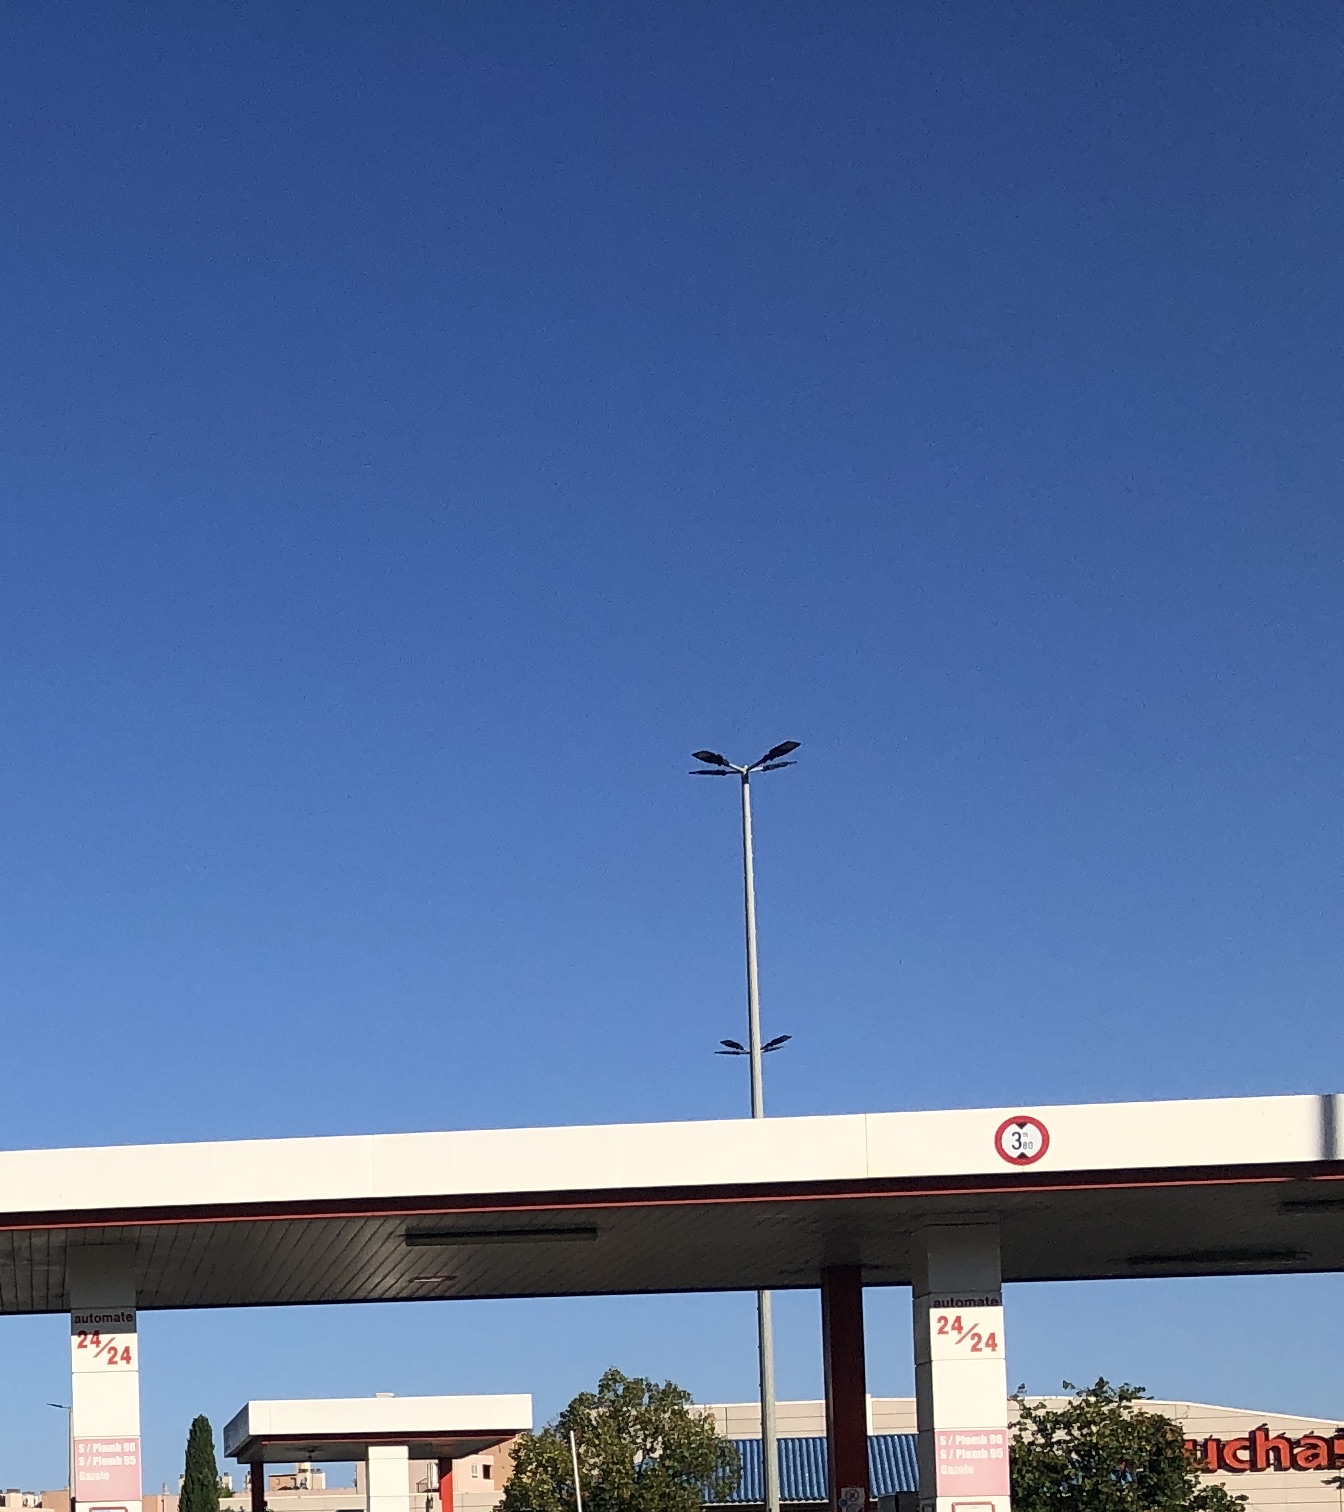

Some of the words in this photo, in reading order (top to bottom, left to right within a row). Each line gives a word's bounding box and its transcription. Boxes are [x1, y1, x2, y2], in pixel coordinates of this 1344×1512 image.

[1012, 1131, 1022, 1150] 3
[933, 1297, 999, 1308] automate
[74, 1312, 133, 1324] automate
[955, 1434, 987, 1445] Plomb
[93, 1442, 122, 1452] Plomb
[956, 1448, 988, 1459] Plomb
[93, 1455, 122, 1466] Plomb
